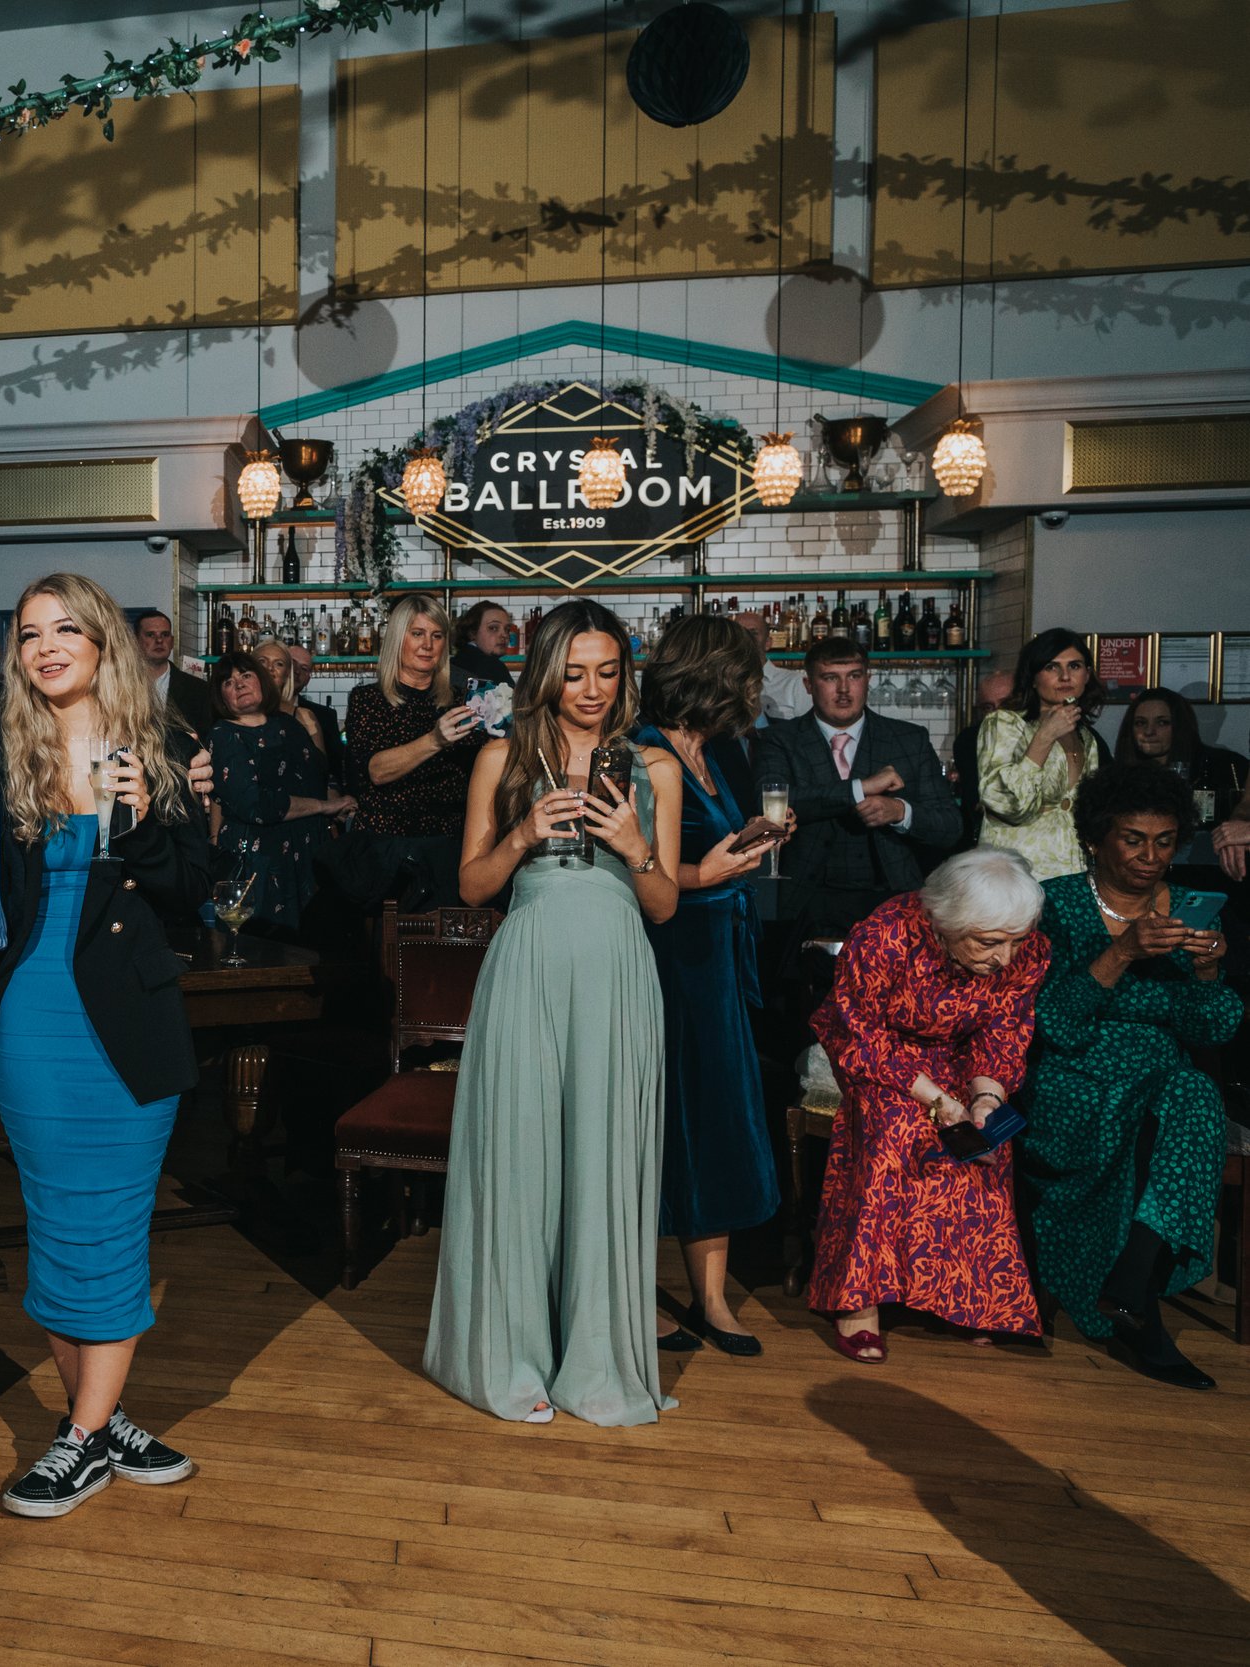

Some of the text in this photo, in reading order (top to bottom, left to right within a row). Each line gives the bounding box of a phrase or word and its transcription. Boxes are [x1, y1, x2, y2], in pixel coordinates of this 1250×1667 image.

[490, 448, 663, 473] CRYSAL
[542, 517, 606, 530] Est.1909
[1100, 638, 1136, 647] UNDER
[1100, 648, 1117, 657] 25?
